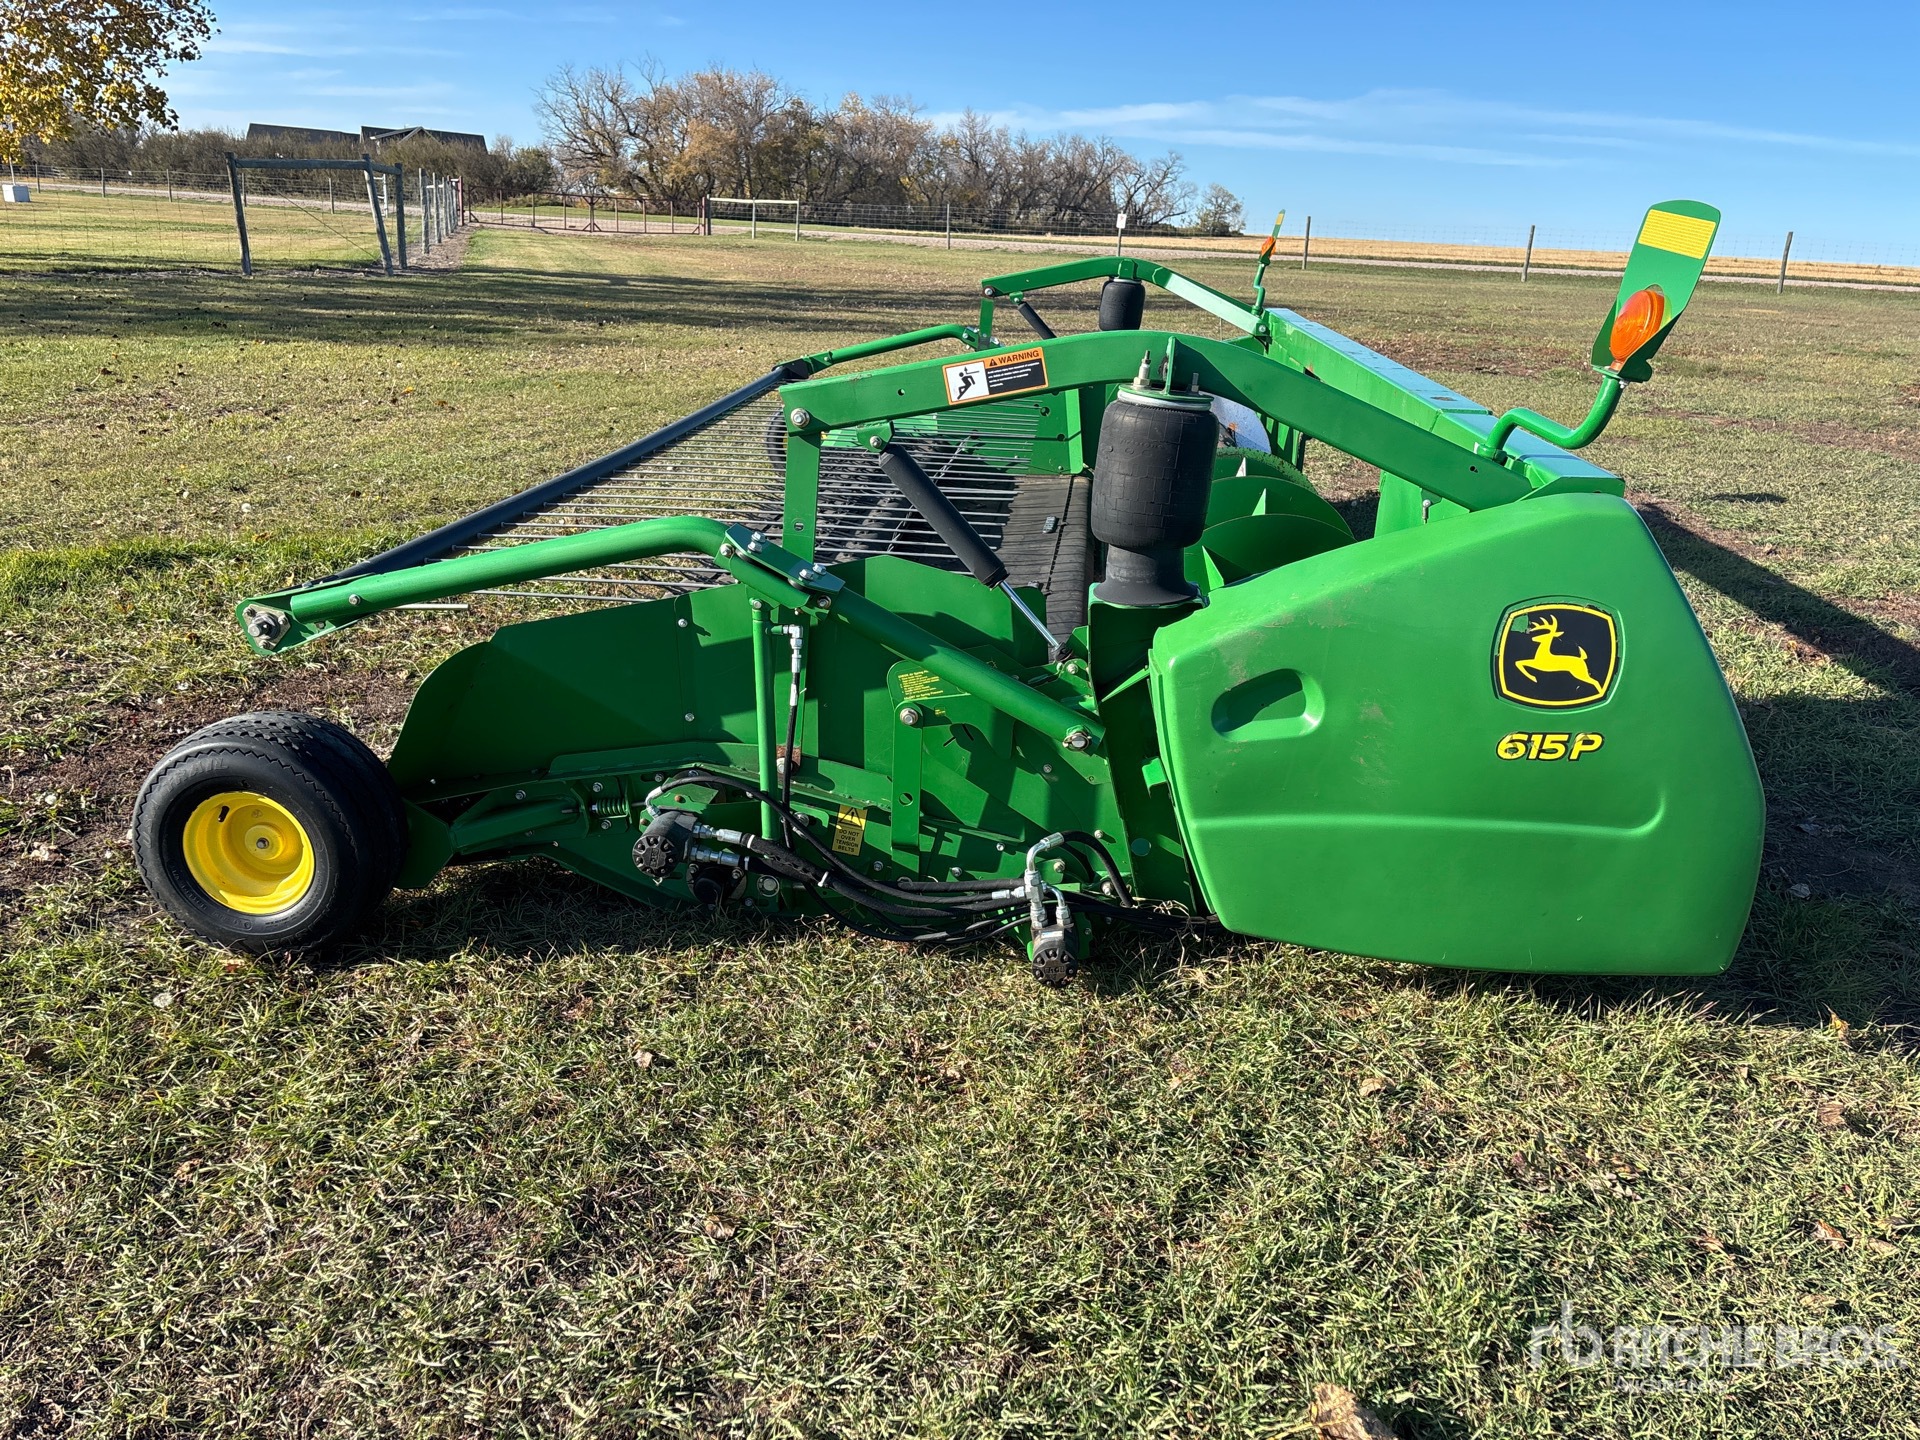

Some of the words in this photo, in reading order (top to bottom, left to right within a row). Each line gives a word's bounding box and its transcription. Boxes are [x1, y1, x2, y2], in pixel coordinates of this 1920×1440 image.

[998, 350, 1040, 364] WARNING
[1496, 732, 1604, 760] 615P
[836, 839, 858, 847] TENSION
